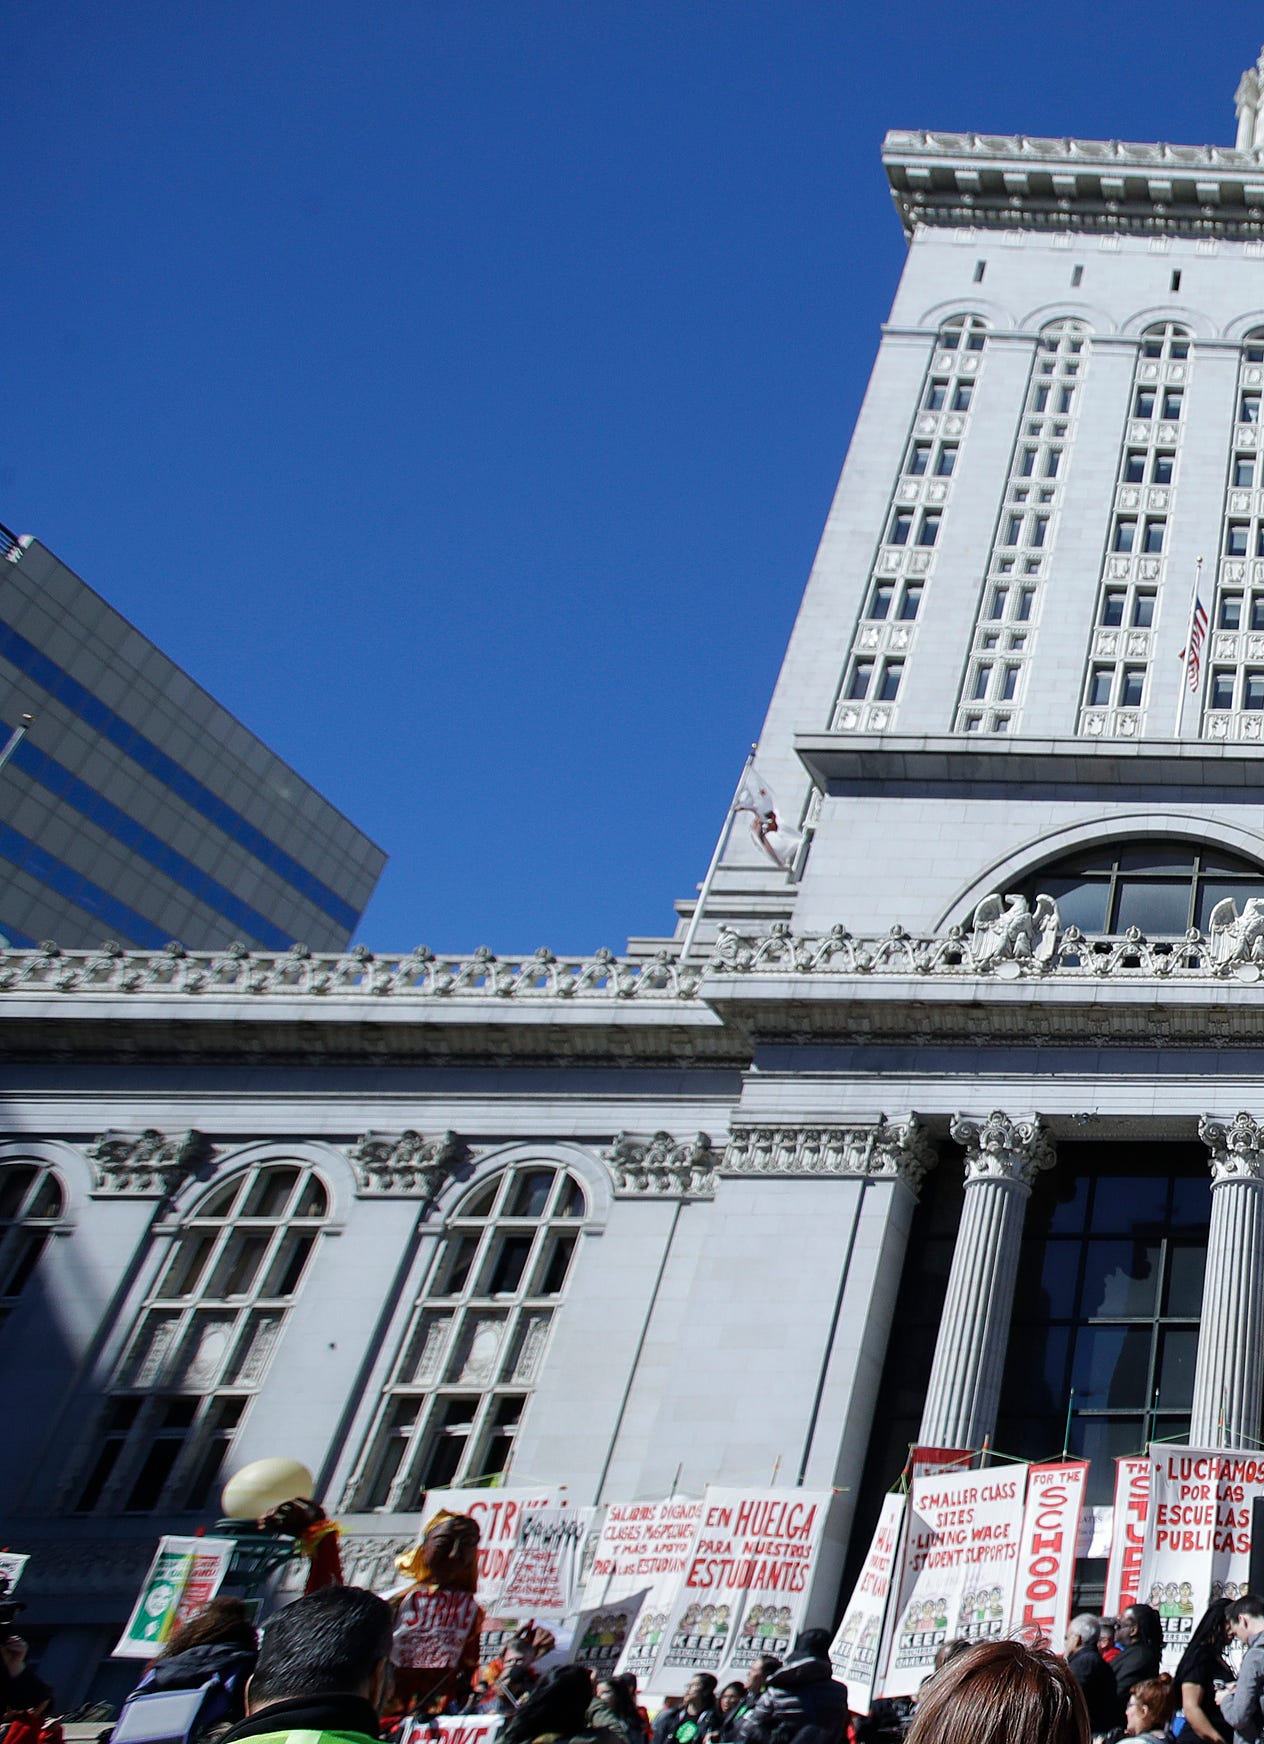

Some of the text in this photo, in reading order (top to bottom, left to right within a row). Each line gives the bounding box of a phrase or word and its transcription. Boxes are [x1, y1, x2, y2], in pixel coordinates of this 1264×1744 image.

[1033, 1471, 1081, 1486] FOR THE
[919, 1482, 1017, 1510] SMALLER CLASS
[1181, 1485, 1245, 1502] POR LAS
[706, 1500, 817, 1541] EN HUELGA
[936, 1509, 975, 1528] SIZES
[1157, 1504, 1250, 1528] ESCUELAS
[972, 1523, 1011, 1541] WAGE
[697, 1540, 813, 1558] PARA NUESTROS
[1156, 1530, 1251, 1554] PUBLICAS
[912, 1549, 963, 1572] STUDENT
[964, 1542, 1017, 1564] SUPPORTS
[686, 1558, 810, 1592] ESTUDIANTES
[405, 1589, 475, 1630] STRIKE
[956, 1621, 1002, 1640] KEEP
[671, 1635, 725, 1650] KEEP
[738, 1635, 789, 1651] KEEP
[900, 1632, 946, 1649] KEEP
